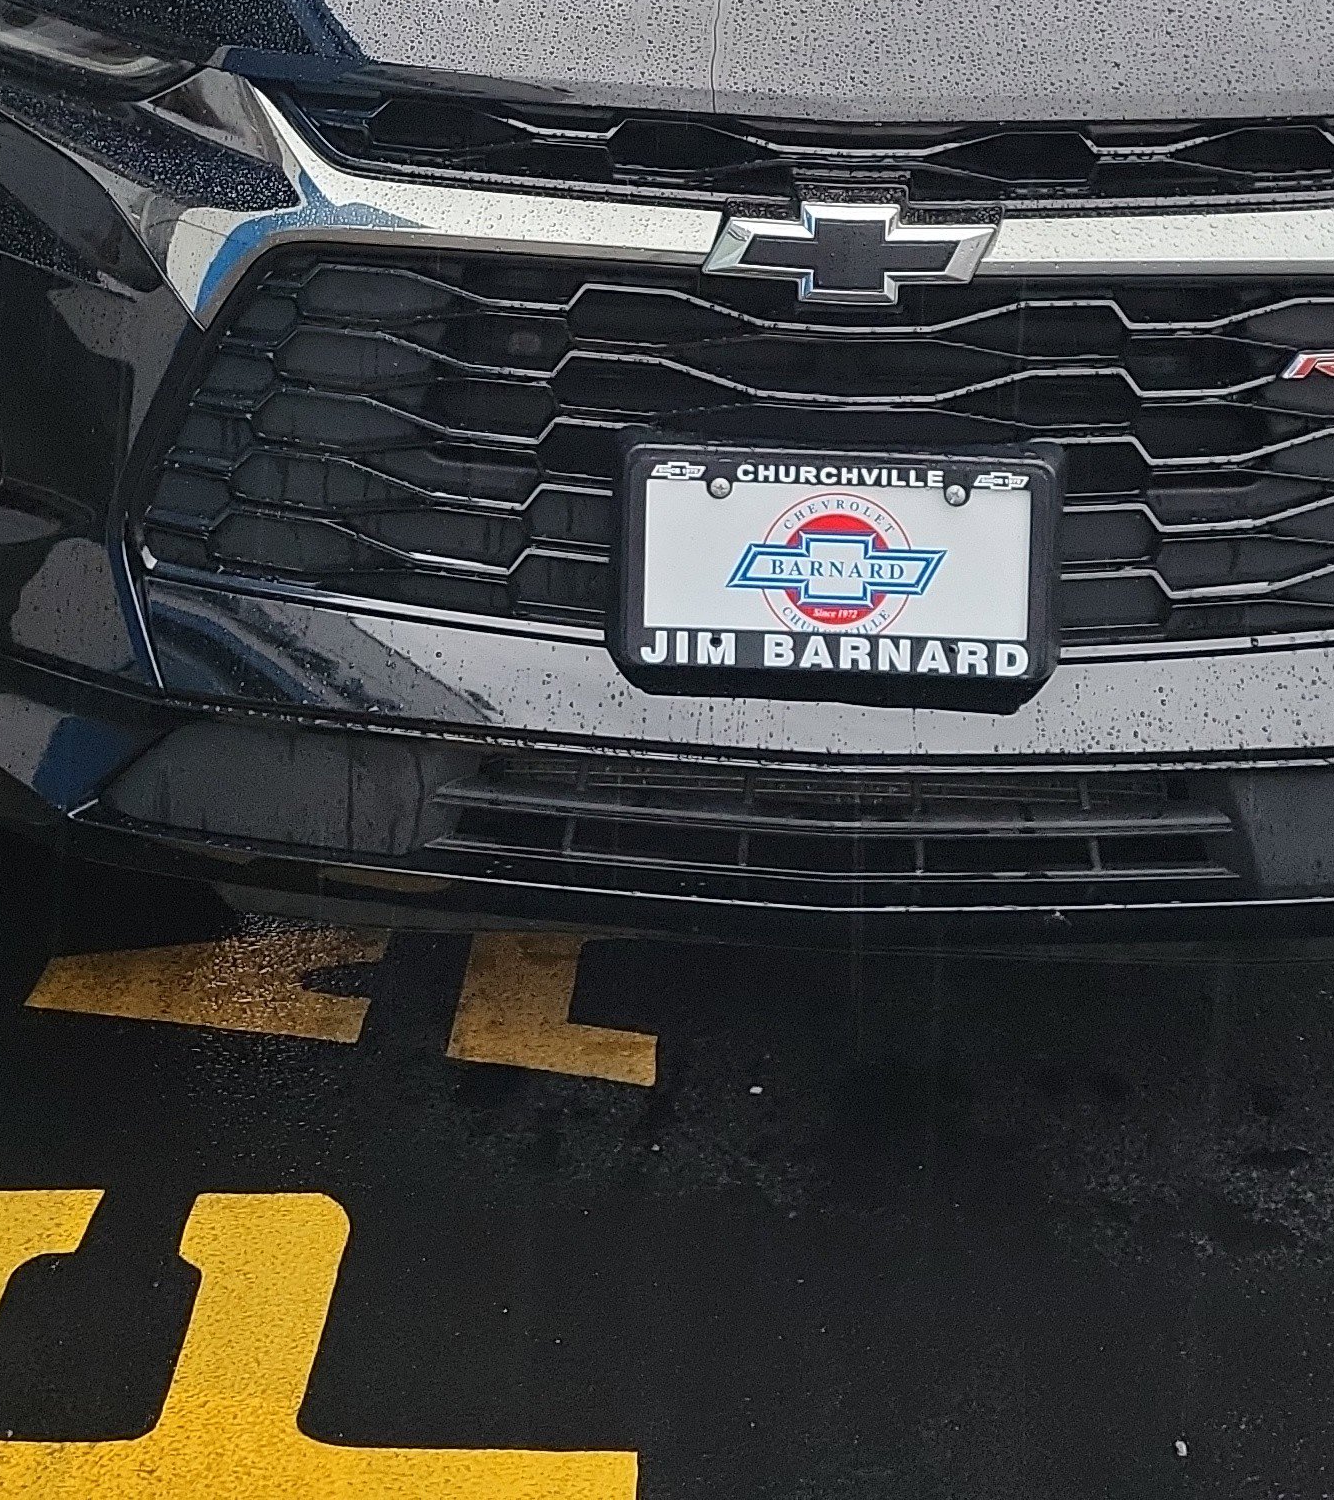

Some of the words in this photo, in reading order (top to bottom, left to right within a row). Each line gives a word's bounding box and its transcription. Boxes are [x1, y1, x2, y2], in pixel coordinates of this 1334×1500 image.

[737, 464, 944, 488] CHURCHVILLE
[783, 499, 896, 535] CHEVROLET
[770, 558, 905, 580] BARNARD
[812, 608, 838, 618] Since
[837, 609, 858, 619] 1972
[640, 630, 736, 665] JIM
[763, 633, 1029, 677] BARNARD
